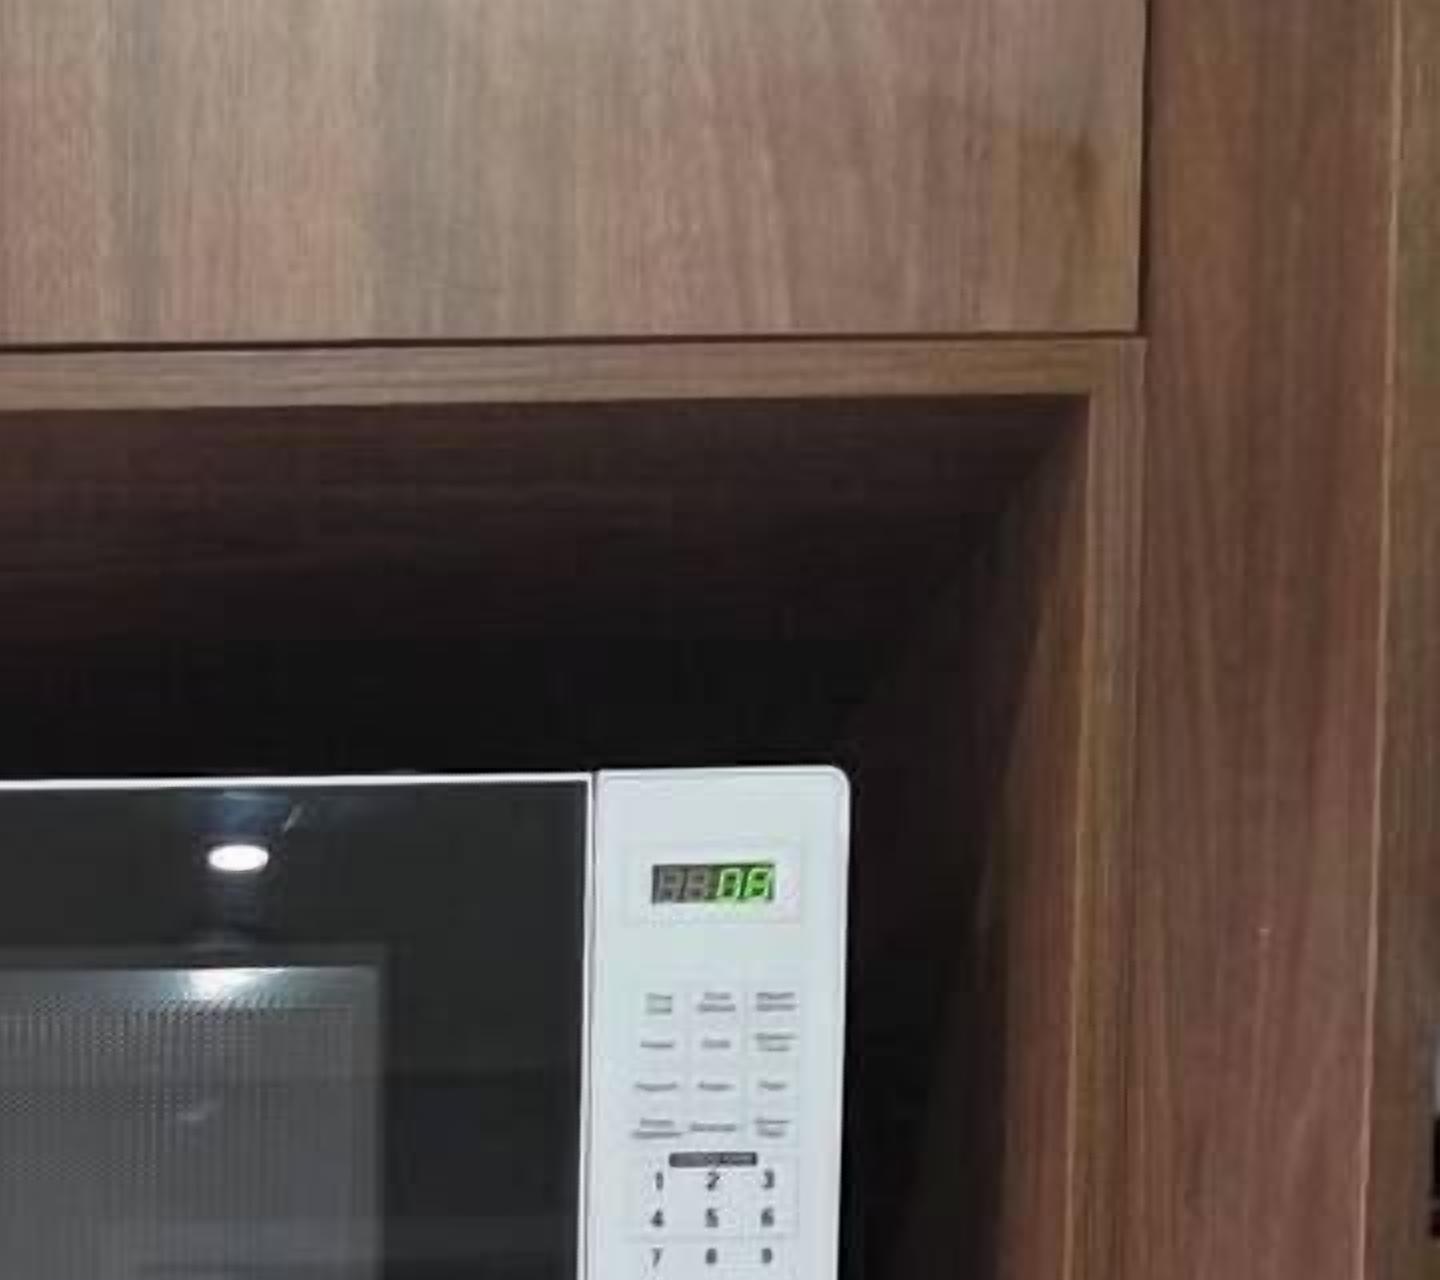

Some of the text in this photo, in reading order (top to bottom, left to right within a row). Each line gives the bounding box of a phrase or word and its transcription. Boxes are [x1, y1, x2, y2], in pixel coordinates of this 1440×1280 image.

[655, 1169, 775, 1192] 1 2 3
[650, 1207, 775, 1228] 4 5 6
[651, 1247, 773, 1268] 7 8 9
